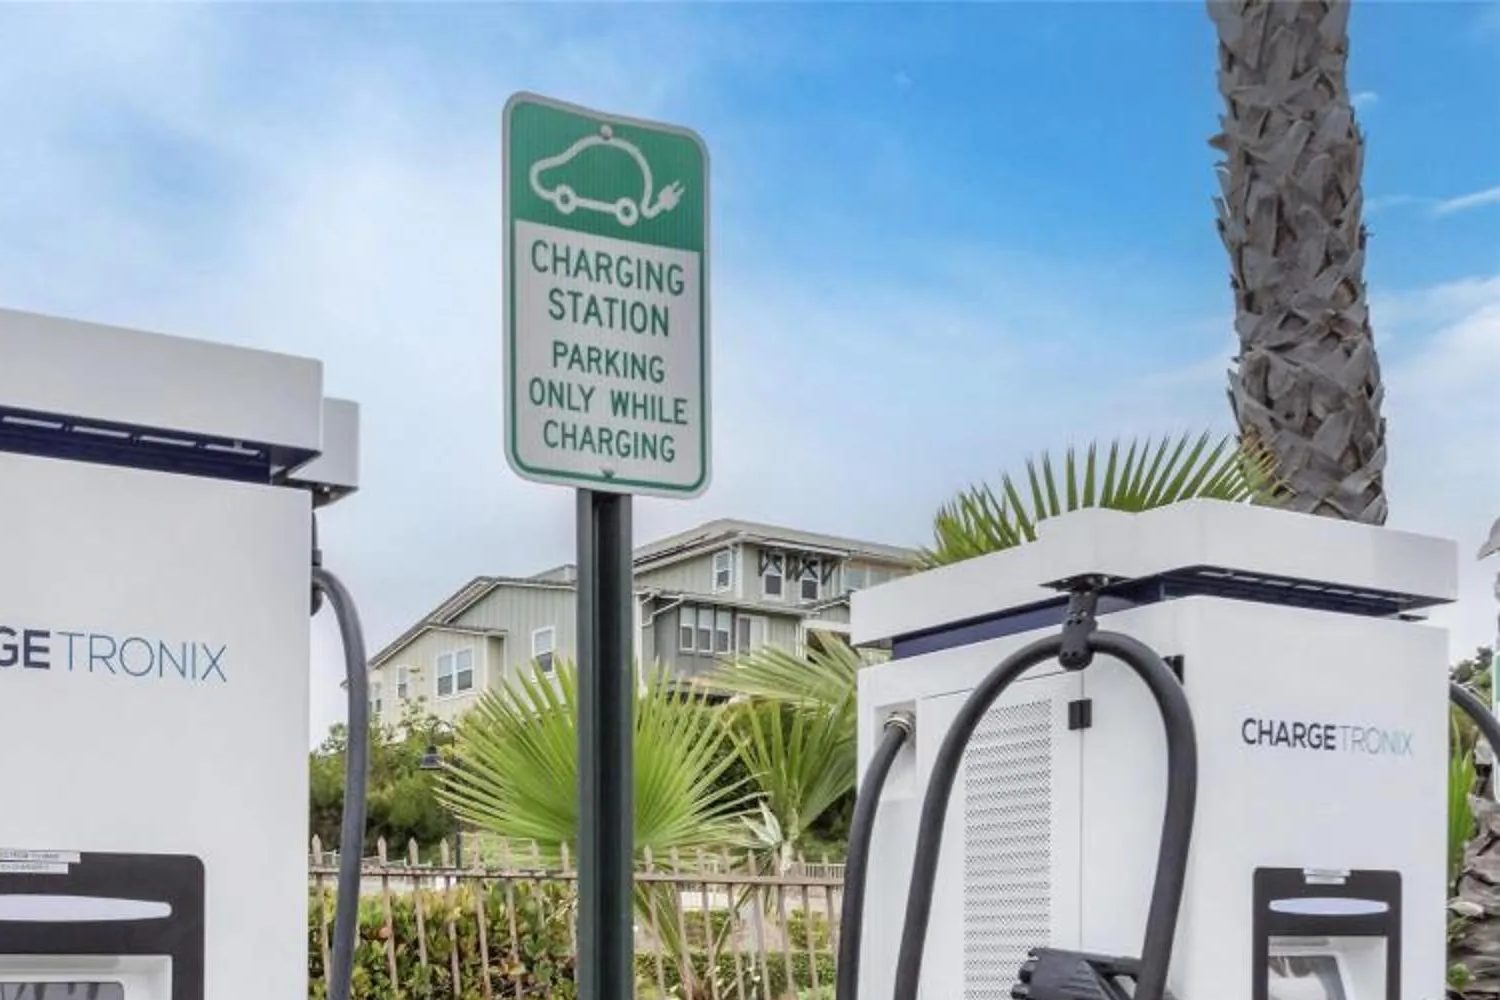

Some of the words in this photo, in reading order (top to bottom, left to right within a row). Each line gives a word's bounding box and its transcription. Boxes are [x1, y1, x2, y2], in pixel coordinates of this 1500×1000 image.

[531, 240, 685, 296] CHARGING
[548, 288, 669, 337] STATION
[552, 341, 665, 384] PARKING
[529, 377, 595, 413] ONLY
[610, 390, 688, 425] WHILE
[543, 420, 675, 463] CHARGING
[1241, 717, 1414, 756] CHARGETRONIX
